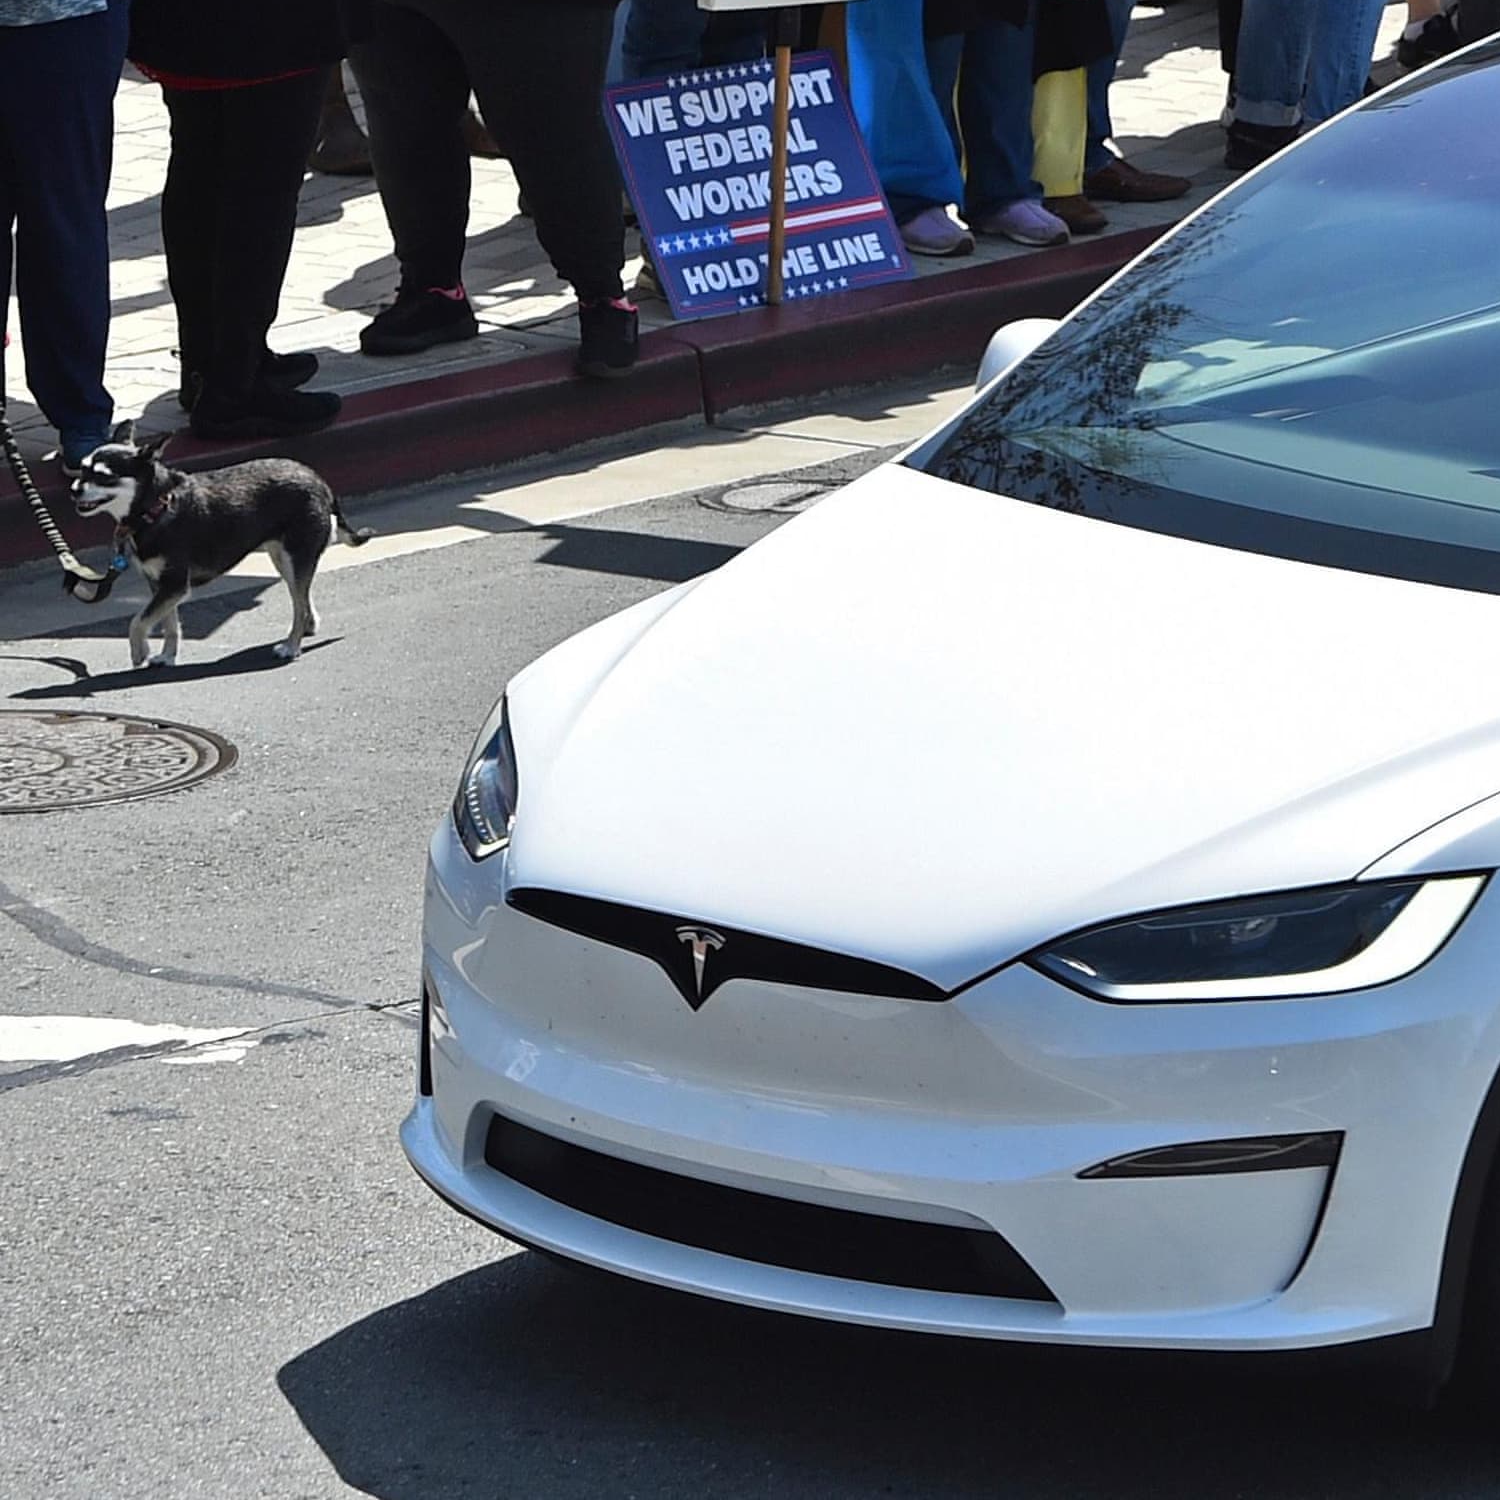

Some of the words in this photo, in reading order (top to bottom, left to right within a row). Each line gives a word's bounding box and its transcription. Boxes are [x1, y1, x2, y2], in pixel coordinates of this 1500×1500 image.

[615, 96, 678, 138] WE
[682, 257, 760, 295] HOLD
[819, 233, 886, 268] LINE
